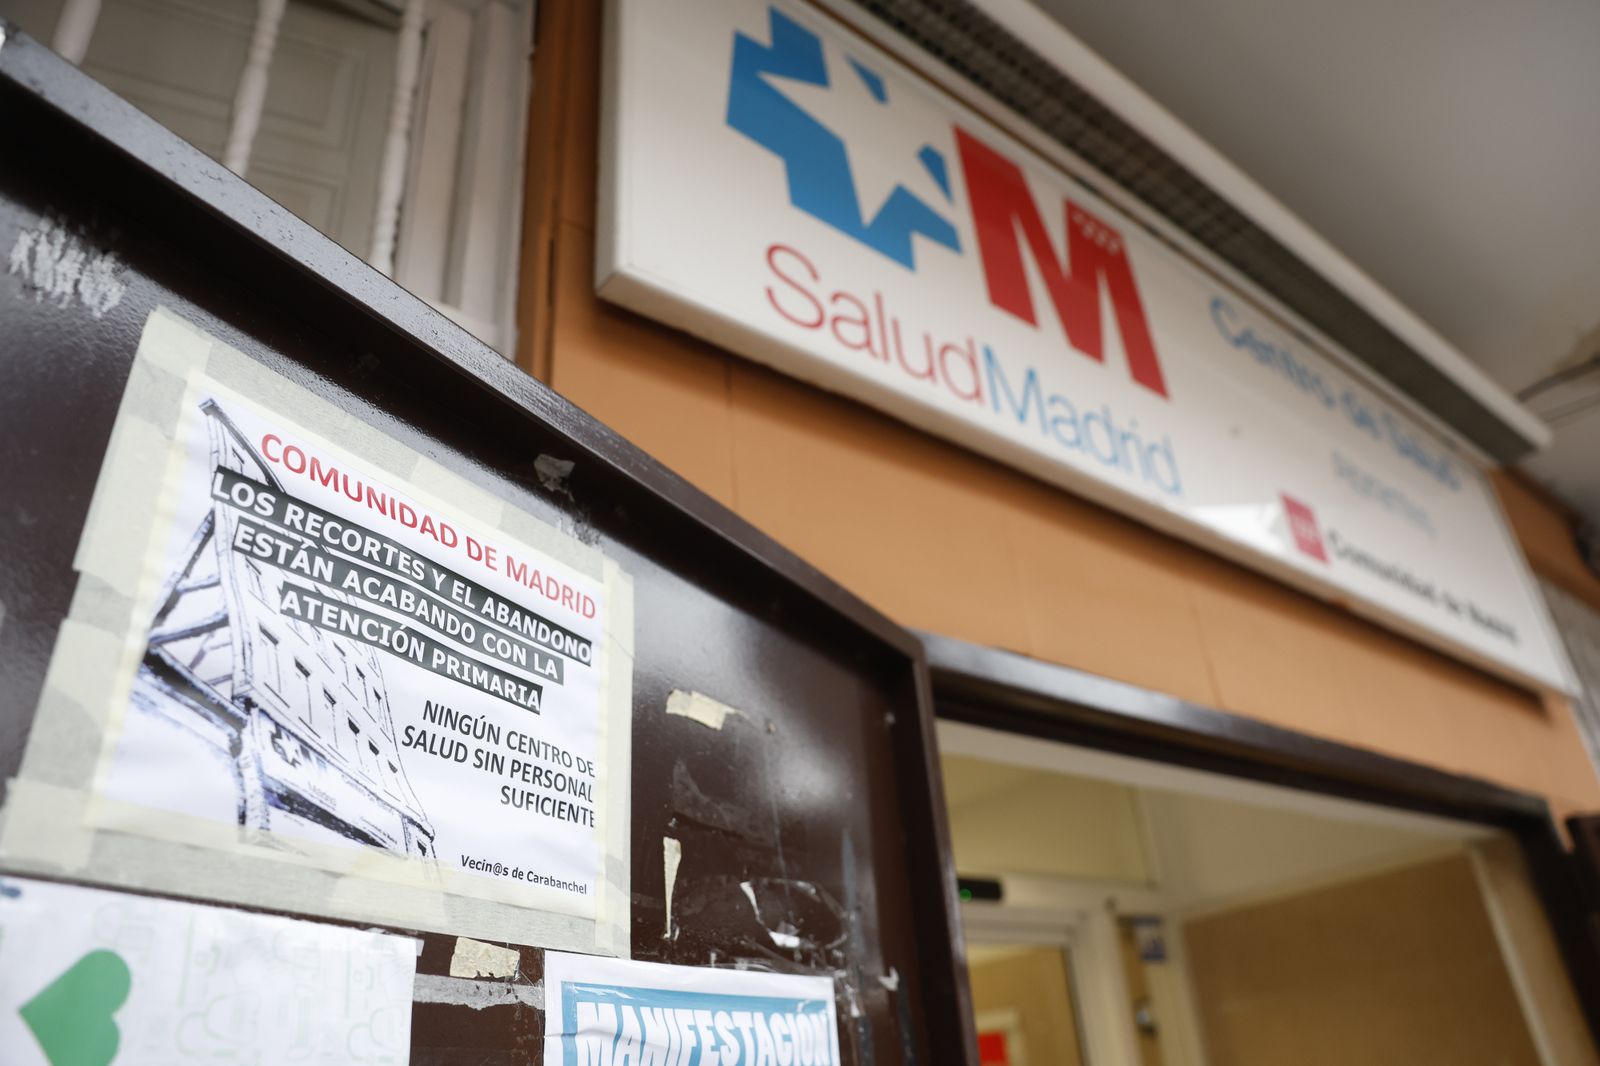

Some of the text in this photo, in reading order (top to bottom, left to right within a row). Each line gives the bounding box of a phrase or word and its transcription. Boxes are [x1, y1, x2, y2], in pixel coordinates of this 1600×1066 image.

[211, 472, 591, 664] LOS RECORTES Y EL ABANDONO
[261, 433, 597, 620] COMUNIDAD DE MADRID
[234, 526, 559, 680] ESTÁN ACABANDO CON LA
[280, 590, 541, 712] ATENCIÓN PRIMARIA
[401, 725, 593, 803] SALUD SIN PERSONAL
[422, 700, 595, 778] NINGÚN CENTRO DE
[500, 785, 595, 828] SUFICIENTE
[461, 855, 588, 895] Vecin@s de Carabanchel
